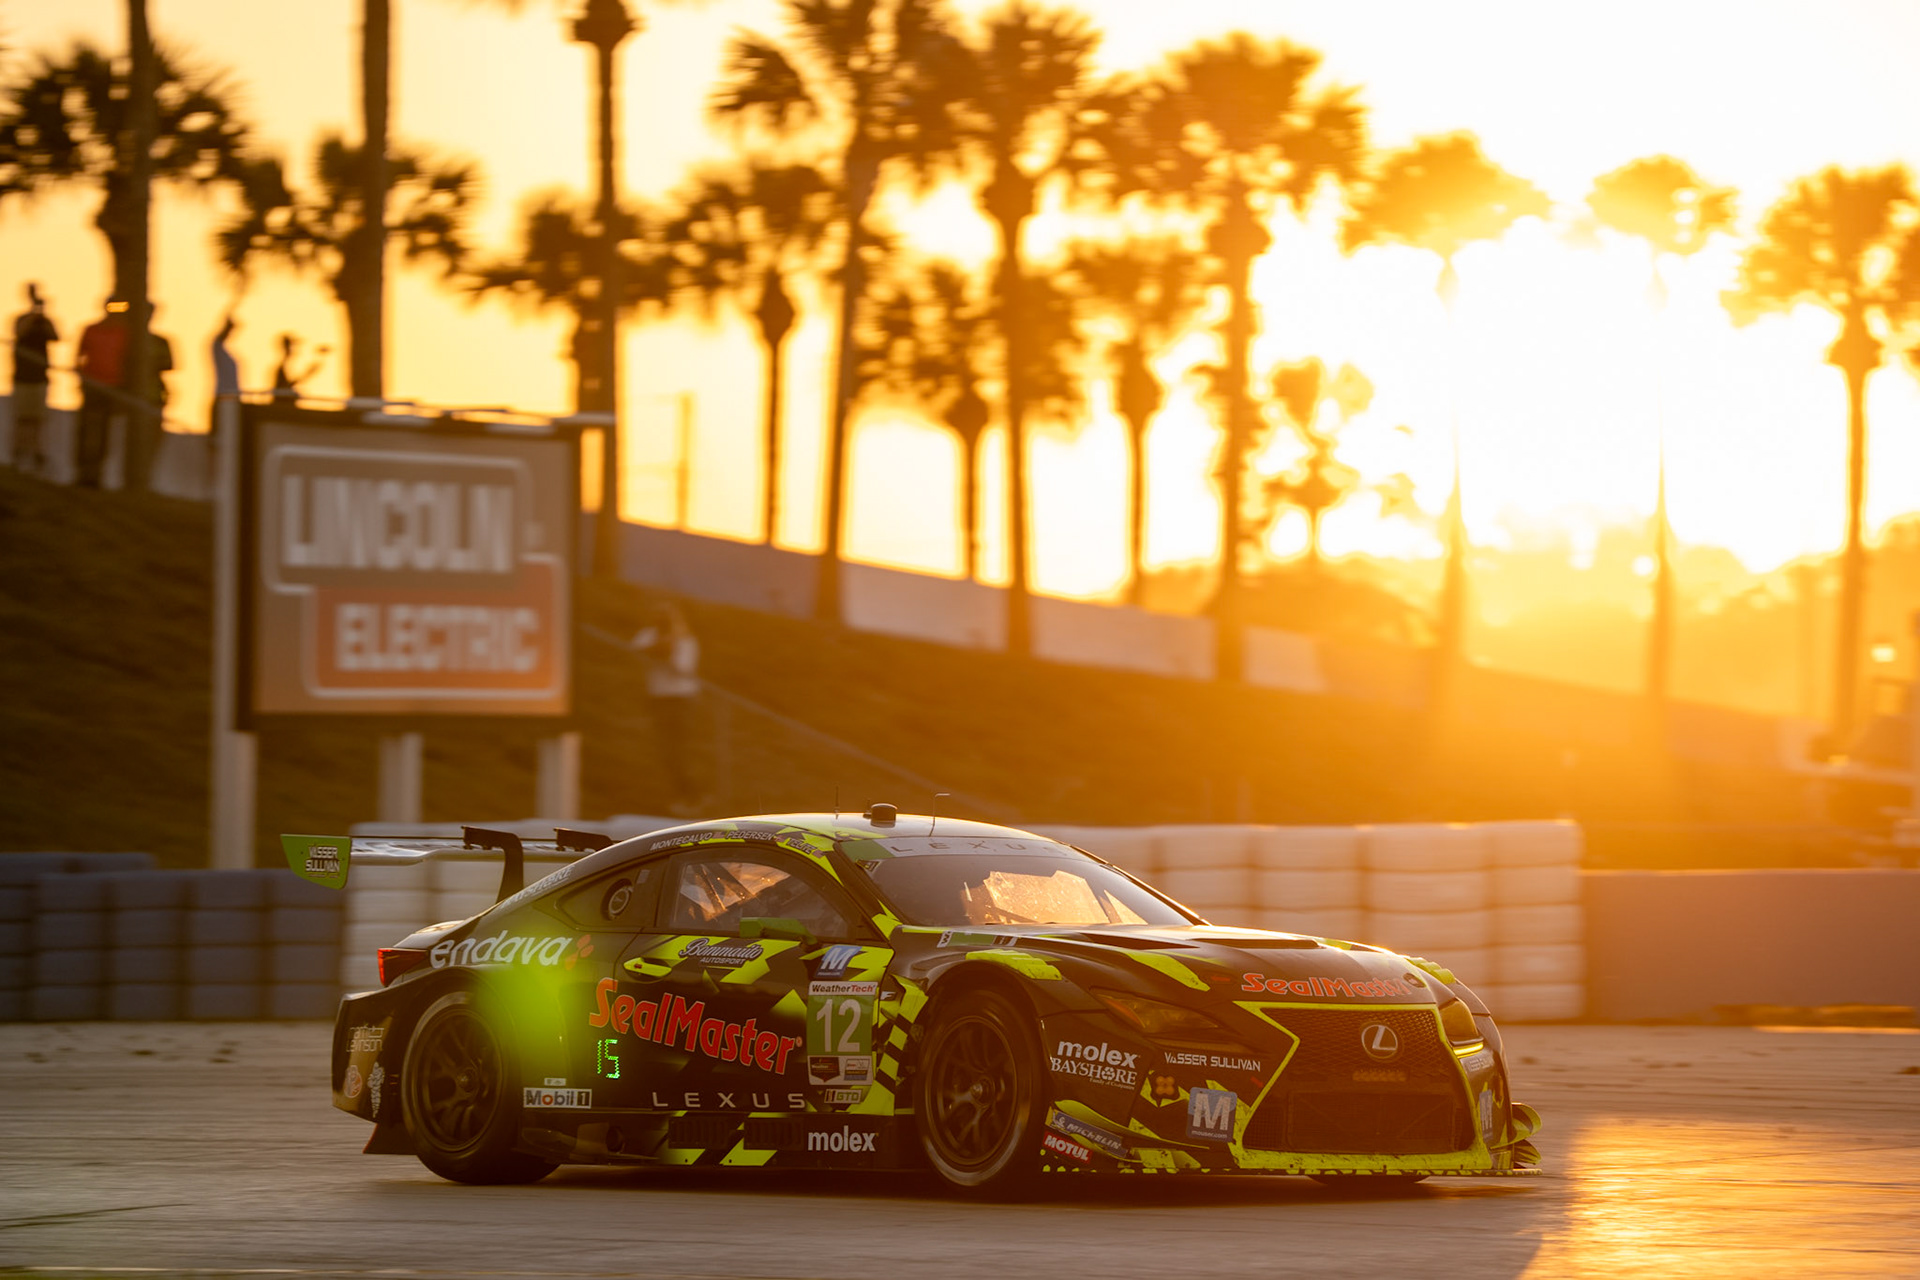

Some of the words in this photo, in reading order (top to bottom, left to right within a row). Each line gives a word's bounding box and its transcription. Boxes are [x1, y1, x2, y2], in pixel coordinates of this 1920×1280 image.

[282, 474, 515, 573] LINCOLN
[334, 602, 540, 672] ELECTRIC
[650, 831, 713, 851] MONTECALVO
[726, 830, 774, 842] PEDERSEN
[430, 930, 573, 970] endava
[700, 957, 746, 965] AUTOSPORT
[820, 946, 858, 970] M
[812, 984, 874, 993] WeatherTech
[589, 977, 799, 1075] SealMaster
[816, 998, 861, 1052] 12
[597, 1039, 620, 1079] 15
[1057, 1041, 1138, 1069] molex
[1164, 1052, 1207, 1066] VASSER
[1210, 1055, 1261, 1072] SULLIVAN
[526, 1089, 574, 1106] Mobil
[652, 1092, 806, 1108] LEXUS
[1193, 1093, 1232, 1131] M
[808, 1125, 876, 1152] molex
[1044, 1134, 1090, 1161] MOTUL
[1066, 1123, 1122, 1150] MICHELIN
